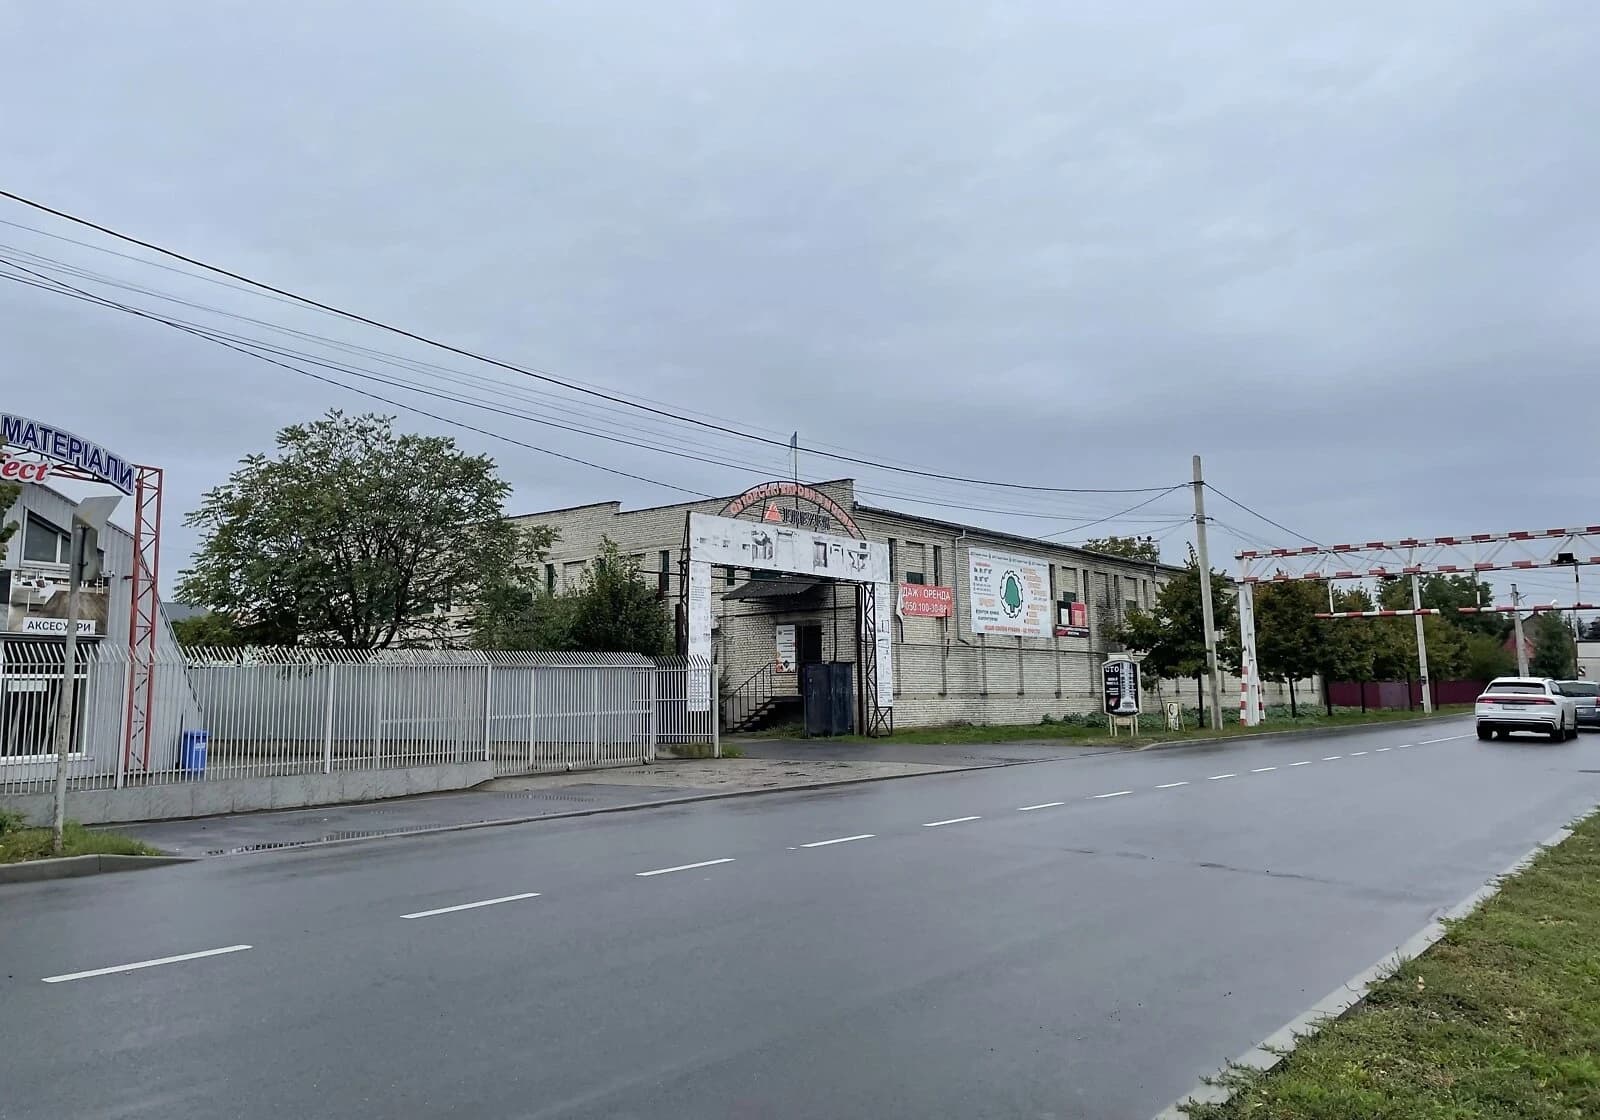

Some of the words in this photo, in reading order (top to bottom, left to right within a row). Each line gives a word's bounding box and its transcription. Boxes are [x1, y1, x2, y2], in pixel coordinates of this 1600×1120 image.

[3, 415, 134, 491] МАТЕРІАЛИ
[923, 589, 950, 601] ОРЕНДА
[27, 620, 91, 632] АКСЕСУРИ
